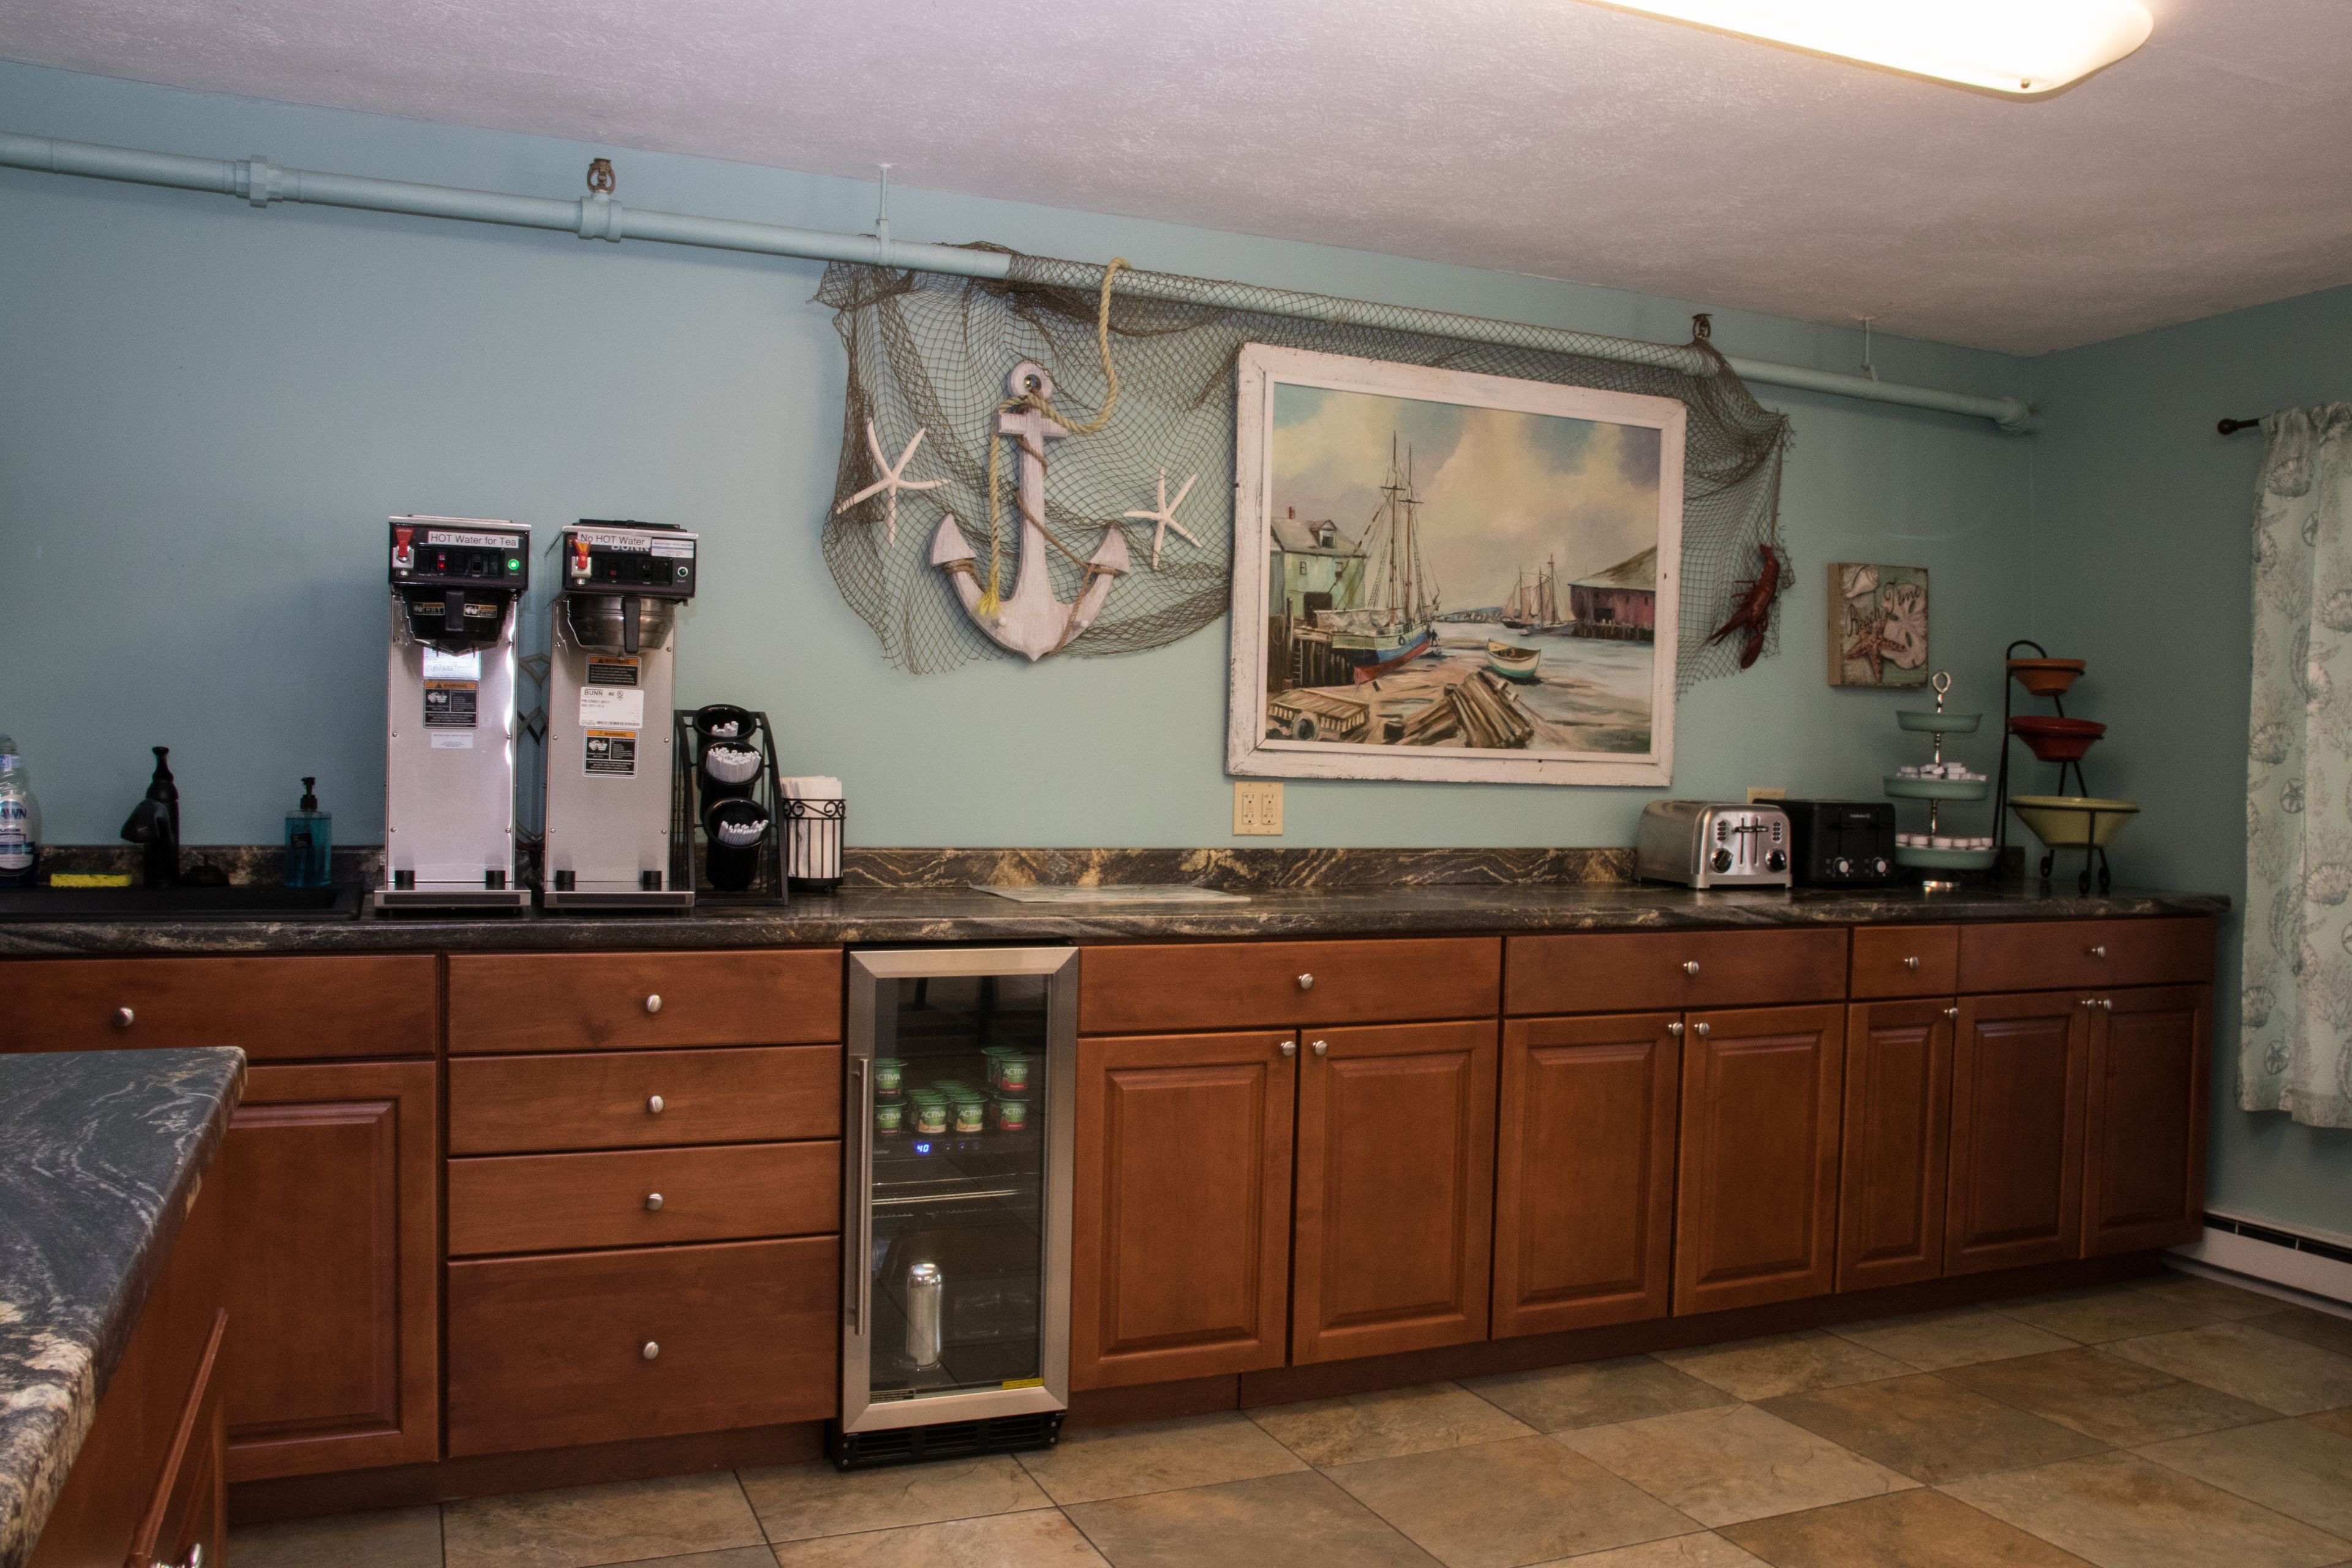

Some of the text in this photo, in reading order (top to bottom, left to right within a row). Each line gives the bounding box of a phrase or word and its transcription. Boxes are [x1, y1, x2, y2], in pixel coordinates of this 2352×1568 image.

[431, 533, 516, 546] HOT Water for Tea
[581, 533, 645, 545] No HOT Water
[0, 808, 27, 820] AWN
[917, 1144, 929, 1153] 40
